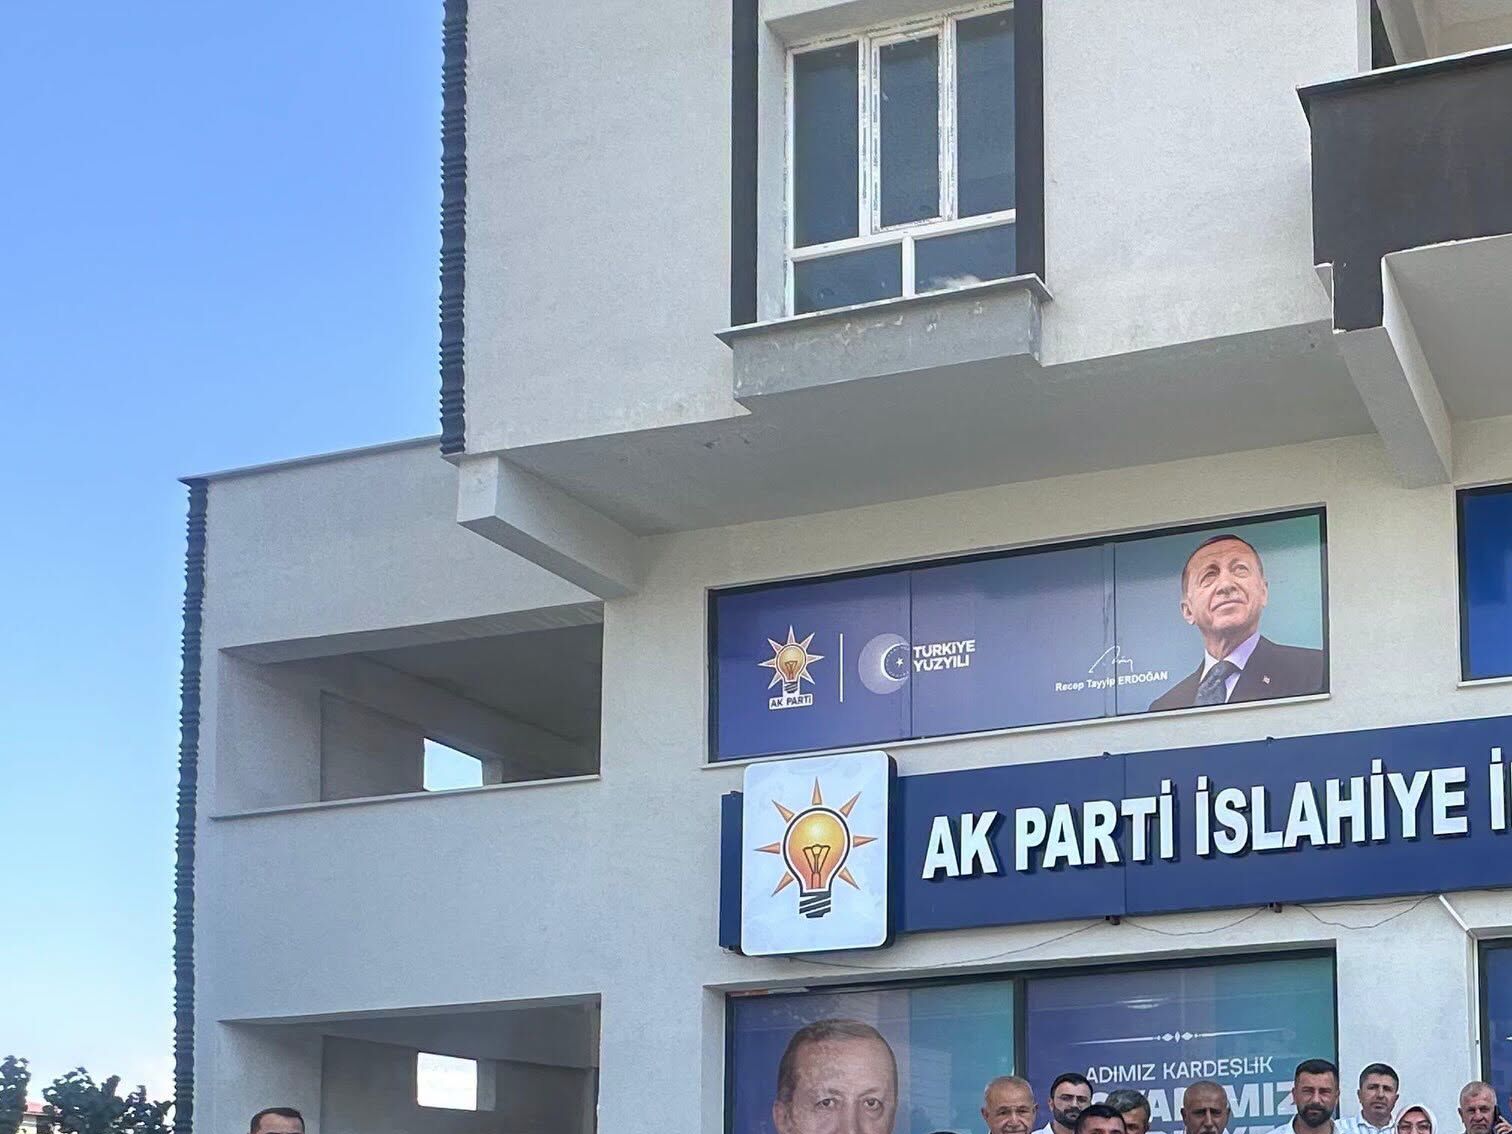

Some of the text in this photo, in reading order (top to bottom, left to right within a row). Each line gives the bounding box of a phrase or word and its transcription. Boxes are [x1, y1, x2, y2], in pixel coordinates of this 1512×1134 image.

[1055, 671, 1168, 692] Recep Tayyip ERDOĞAN
[771, 699, 783, 708] AK
[921, 810, 998, 880] AK
[1015, 778, 1174, 871] PARTİ
[1196, 758, 1469, 856] İSLAHİYE
[1086, 1063, 1156, 1084] ADIMIZ
